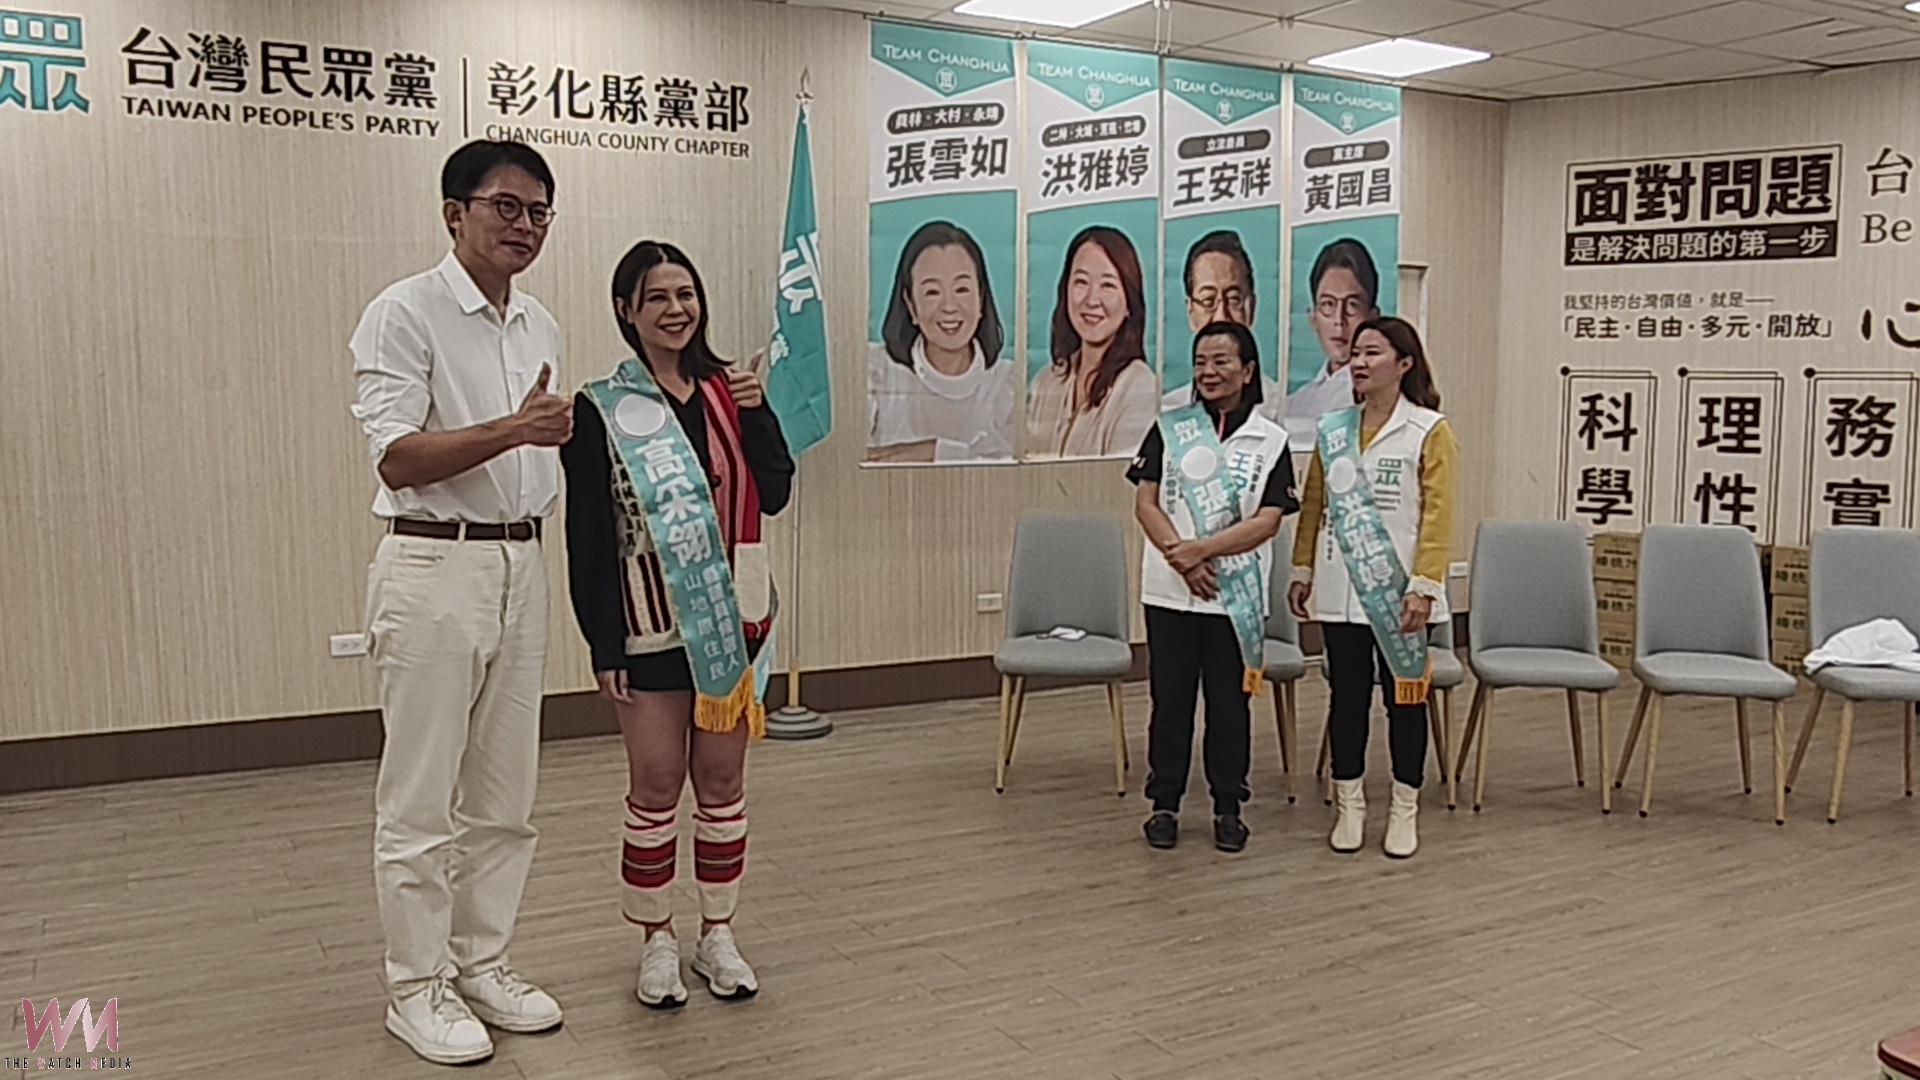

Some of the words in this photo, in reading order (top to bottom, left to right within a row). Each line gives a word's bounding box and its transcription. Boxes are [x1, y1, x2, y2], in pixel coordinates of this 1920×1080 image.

[121, 27, 437, 109] 台灣民眾黨
[882, 44, 922, 61] TEAM
[1037, 62, 1073, 77] TEAM
[486, 60, 750, 133] 彰化縣黨部
[1174, 78, 1206, 94] TEAM
[1301, 87, 1332, 103] TEAM
[122, 95, 231, 123] TAIWAN
[243, 106, 354, 131] PEOPLE'S
[366, 115, 440, 137] PARTY
[486, 124, 592, 148] CHANGHUA
[597, 132, 670, 153] COUNTY
[674, 137, 750, 158] CHAPTER
[886, 136, 1009, 188] 張雪如
[1042, 145, 1150, 198] 洪雅婷
[1173, 156, 1272, 208] 王安祥
[1866, 147, 1913, 197] 台
[1303, 167, 1392, 214] 黃國昌
[1574, 153, 1834, 227] 面對問題
[1570, 227, 1830, 264] 是解決問題的第一步
[1575, 392, 1638, 526] 科學
[1693, 396, 1762, 533] 理性
[1823, 395, 1897, 527] 務實
[1337, 491, 1395, 592] 洪雅婷
